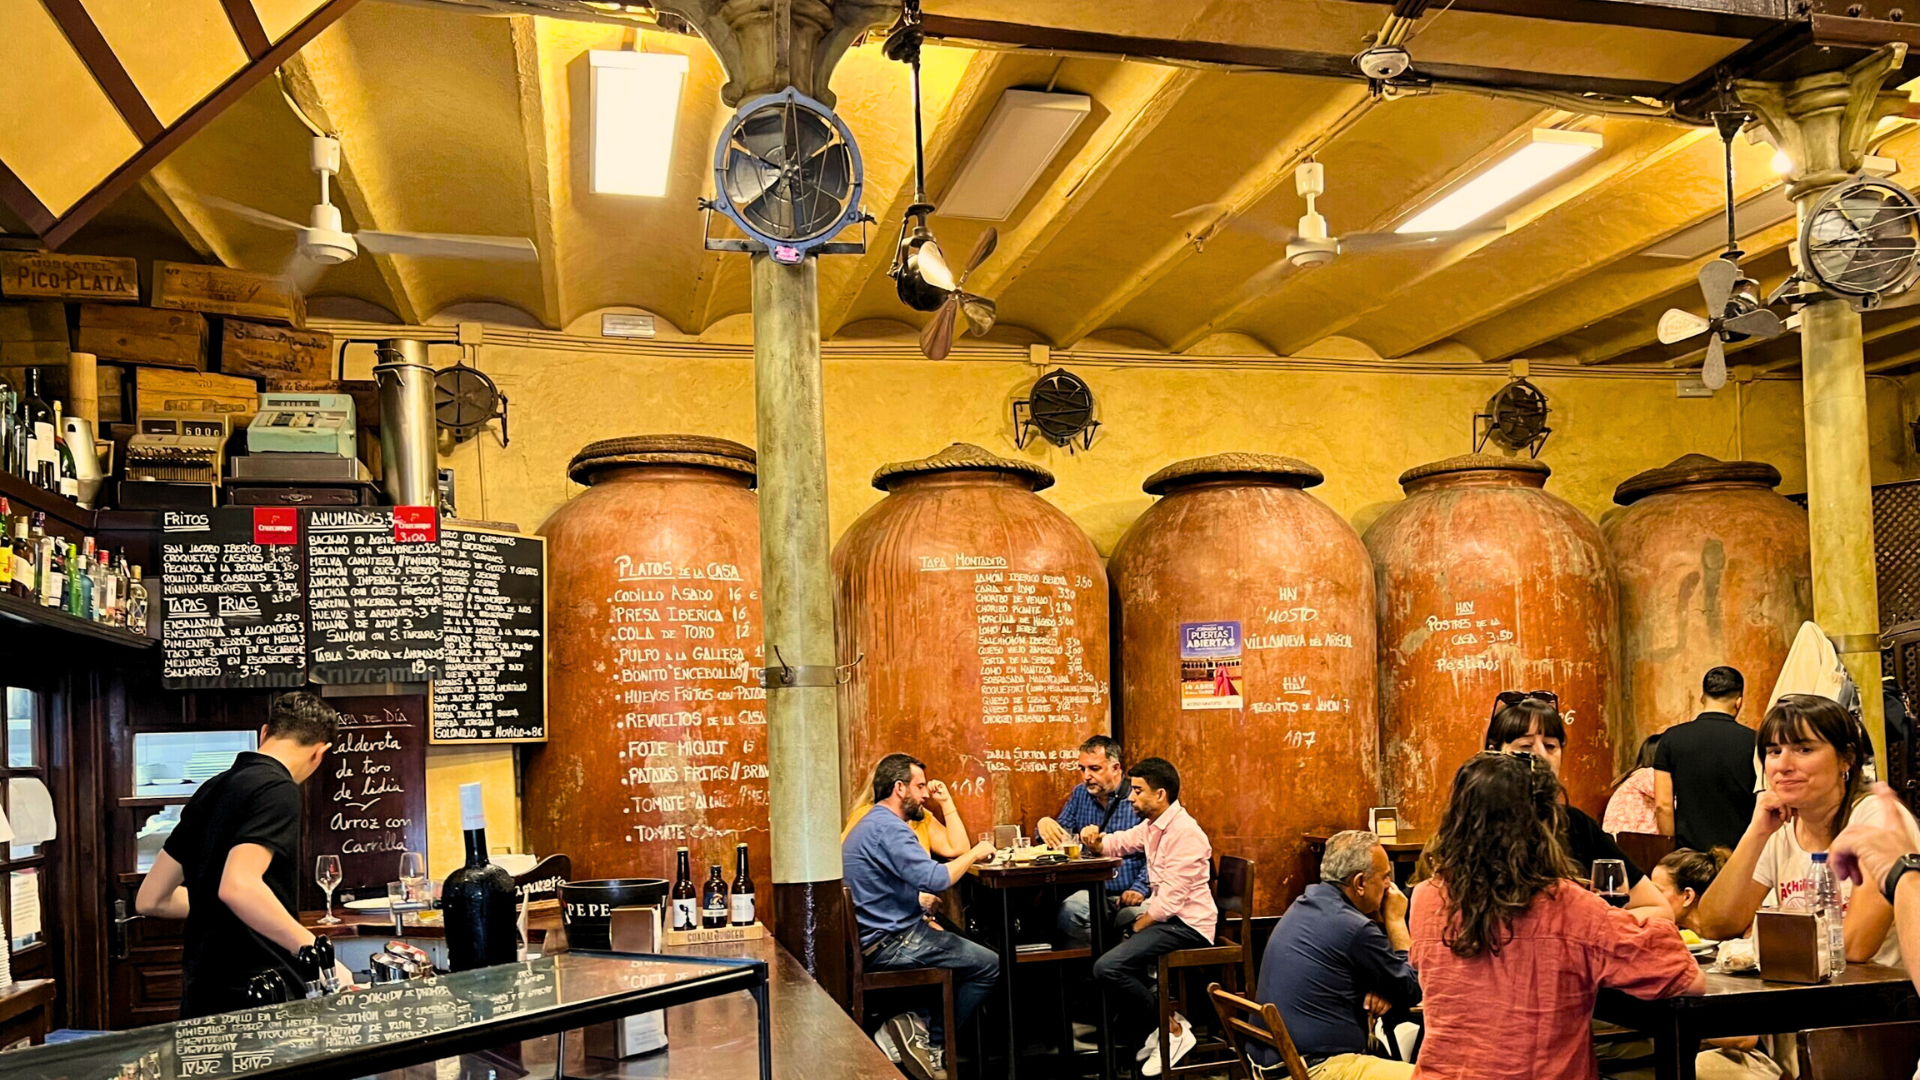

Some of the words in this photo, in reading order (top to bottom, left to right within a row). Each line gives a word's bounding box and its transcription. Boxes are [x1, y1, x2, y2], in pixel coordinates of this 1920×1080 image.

[308, 535, 348, 545] BACALAO
[354, 536, 364, 544] EN
[164, 544, 183, 553] SAN
[189, 544, 220, 553] JACOBO
[224, 542, 261, 553] IBERICO
[356, 546, 372, 554] CON
[163, 554, 217, 562] CROQUETAS
[223, 554, 264, 562] CASERAS
[310, 557, 342, 567] MELVA
[348, 556, 395, 566] CANUTERA
[919, 556, 946, 568] TAPA
[956, 552, 1006, 566] MONTADITO
[163, 563, 204, 572] PECHUGA
[372, 567, 401, 575] QUESO
[614, 555, 672, 577] PLATOS
[679, 568, 690, 576] DE
[694, 568, 705, 578] LA
[707, 562, 740, 578] CASA
[162, 572, 197, 583] ROLLITO
[202, 574, 214, 582] DE
[221, 574, 266, 582] CABRALES
[309, 578, 349, 588] ANCHOA
[1008, 572, 1039, 583] IBERICO
[310, 588, 347, 598] ANCHOA
[401, 586, 434, 595] FRESCO
[614, 588, 664, 602] CODILLO
[672, 585, 713, 600] ASADO
[729, 588, 742, 600] 16
[1018, 582, 1035, 594] LOMO
[1280, 587, 1298, 600] HAY
[164, 597, 208, 612] TAPAS
[1013, 594, 1023, 604] DE
[1456, 601, 1474, 613] HAY
[312, 610, 348, 620] HUEVAS
[354, 610, 366, 618] DE
[615, 607, 660, 622] PRESA
[666, 605, 724, 622] IBERICA
[733, 606, 747, 622] 16
[978, 614, 1015, 624] MORCILLA
[1266, 607, 1318, 624] MOSTO
[164, 618, 225, 630] ENSALADILLA
[356, 620, 368, 628] DE
[978, 626, 1000, 634] LOMO
[1002, 626, 1012, 634] AL
[1426, 616, 1472, 632] POSTRES
[1476, 619, 1487, 627] DE
[164, 628, 226, 638] ENSALADILLA
[618, 627, 654, 640] COLA
[661, 630, 676, 638] DE
[681, 624, 714, 639] TORO
[1192, 630, 1228, 640] PUERTAS
[164, 639, 214, 648] PIMIENTOS
[1186, 638, 1235, 648] ABIERTAS
[1244, 634, 1306, 649] VILLANUEVA
[165, 650, 189, 658] TACO
[210, 646, 240, 656] BONITO
[246, 646, 258, 654] EN
[311, 647, 343, 662] TABLA
[346, 645, 392, 660] SURTIDA
[620, 648, 660, 662] PULPO
[676, 651, 687, 660] LA
[692, 646, 744, 660] GALLEGA
[978, 647, 1003, 655] QUESO
[227, 656, 240, 665] EN
[164, 667, 221, 678] SALMOREJO
[622, 668, 668, 682] BONITO
[980, 666, 1002, 674] LOMO
[1282, 676, 1306, 690] HAY
[625, 690, 670, 703] HUEVOS
[674, 686, 713, 701] FRITOS
[718, 691, 733, 700] CON
[336, 713, 358, 724] APA
[626, 712, 702, 728] REVUELTOS
[707, 717, 718, 726] DE
[722, 716, 734, 725] LA
[738, 710, 766, 724] CASA
[628, 741, 668, 757] FOIE
[678, 740, 728, 756] MICUIT
[336, 758, 354, 778] de
[362, 756, 390, 774] toro
[629, 766, 678, 785] PATATAS
[684, 765, 729, 782] FRITAS
[334, 782, 353, 801] de
[361, 776, 404, 796] lidia
[631, 795, 686, 812] TOMATE
[386, 817, 412, 828] con
[634, 824, 686, 842] TOMATE
[342, 831, 408, 854] Carrilla
[568, 903, 611, 916] PEPE
